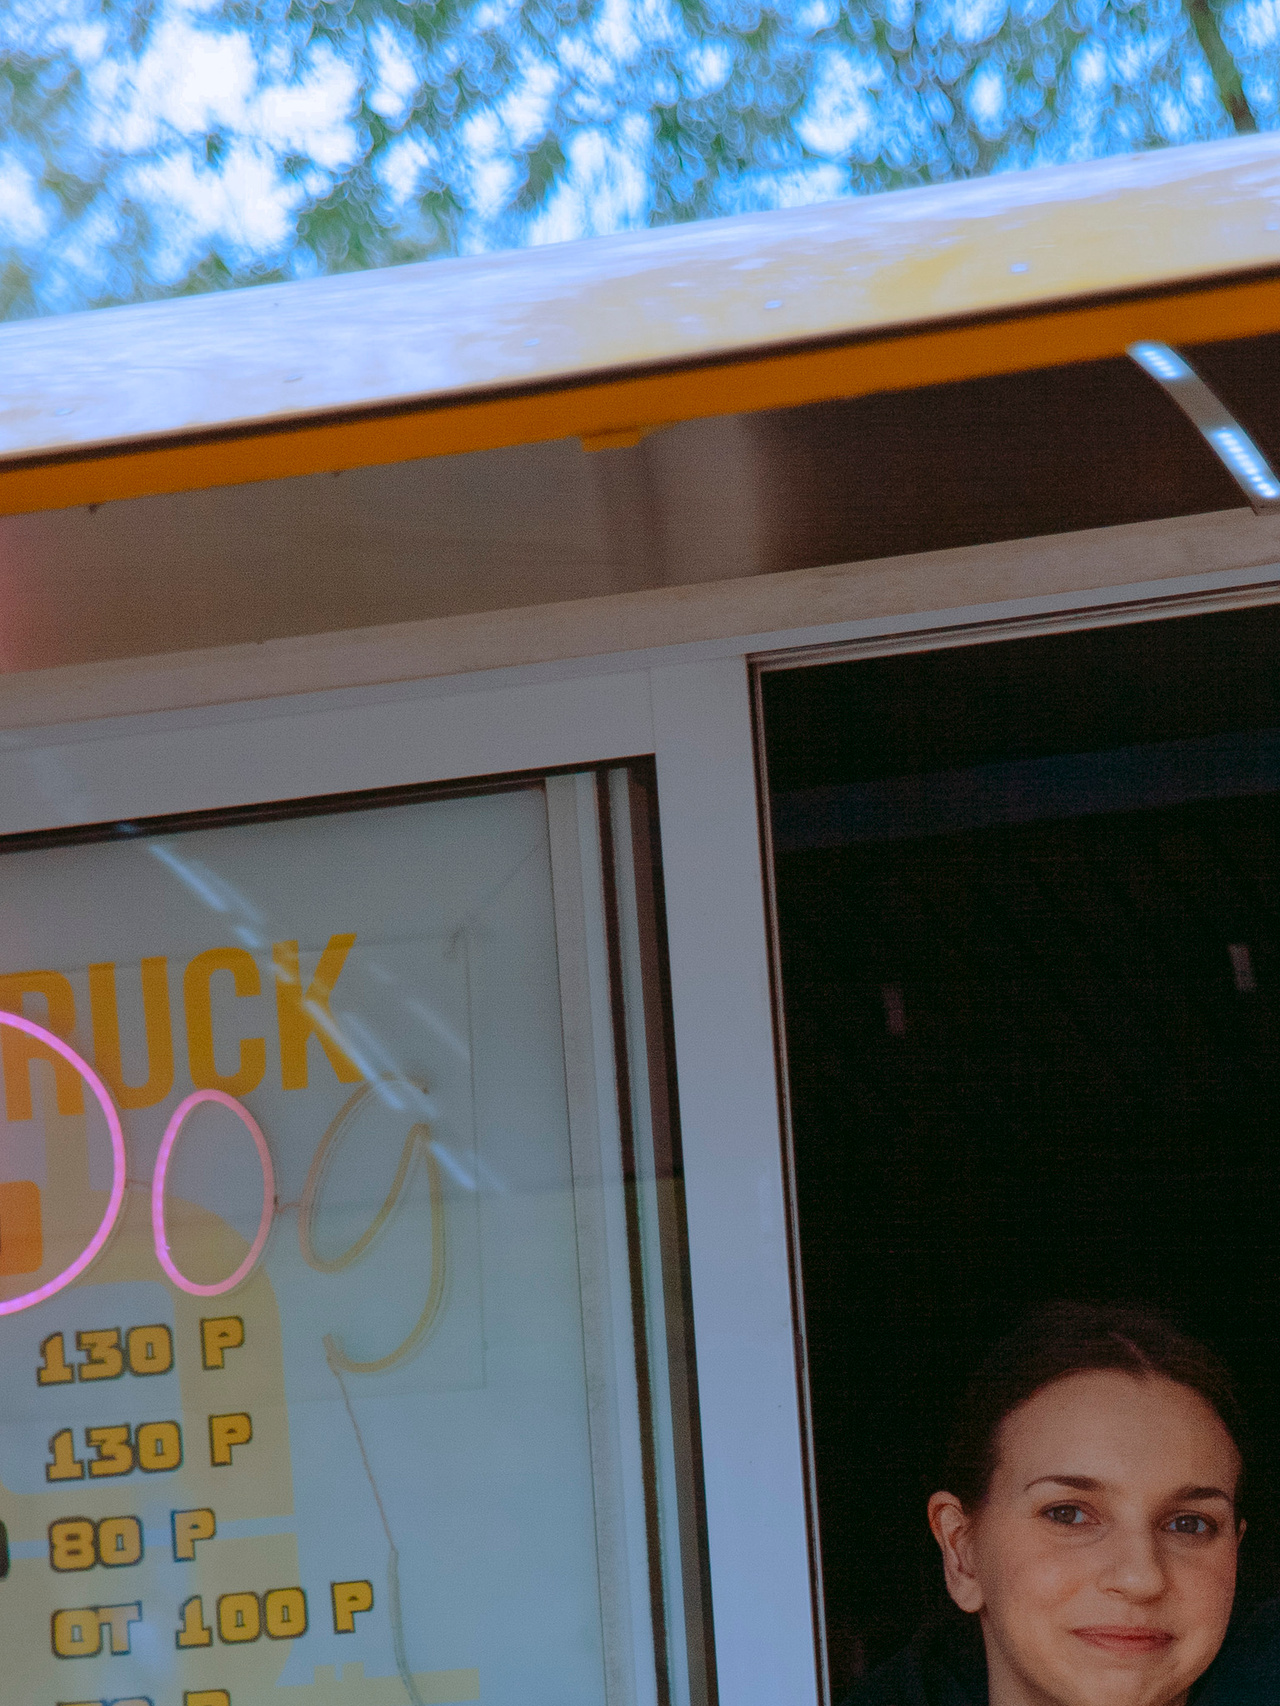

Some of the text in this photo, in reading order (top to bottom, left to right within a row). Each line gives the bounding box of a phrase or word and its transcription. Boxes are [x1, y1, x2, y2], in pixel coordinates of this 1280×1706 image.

[37, 1323, 174, 1387] 130
[46, 1420, 184, 1483] 130
[48, 1515, 144, 1573] 80
[50, 1600, 143, 1660] ОТ
[175, 1586, 309, 1650] 100
